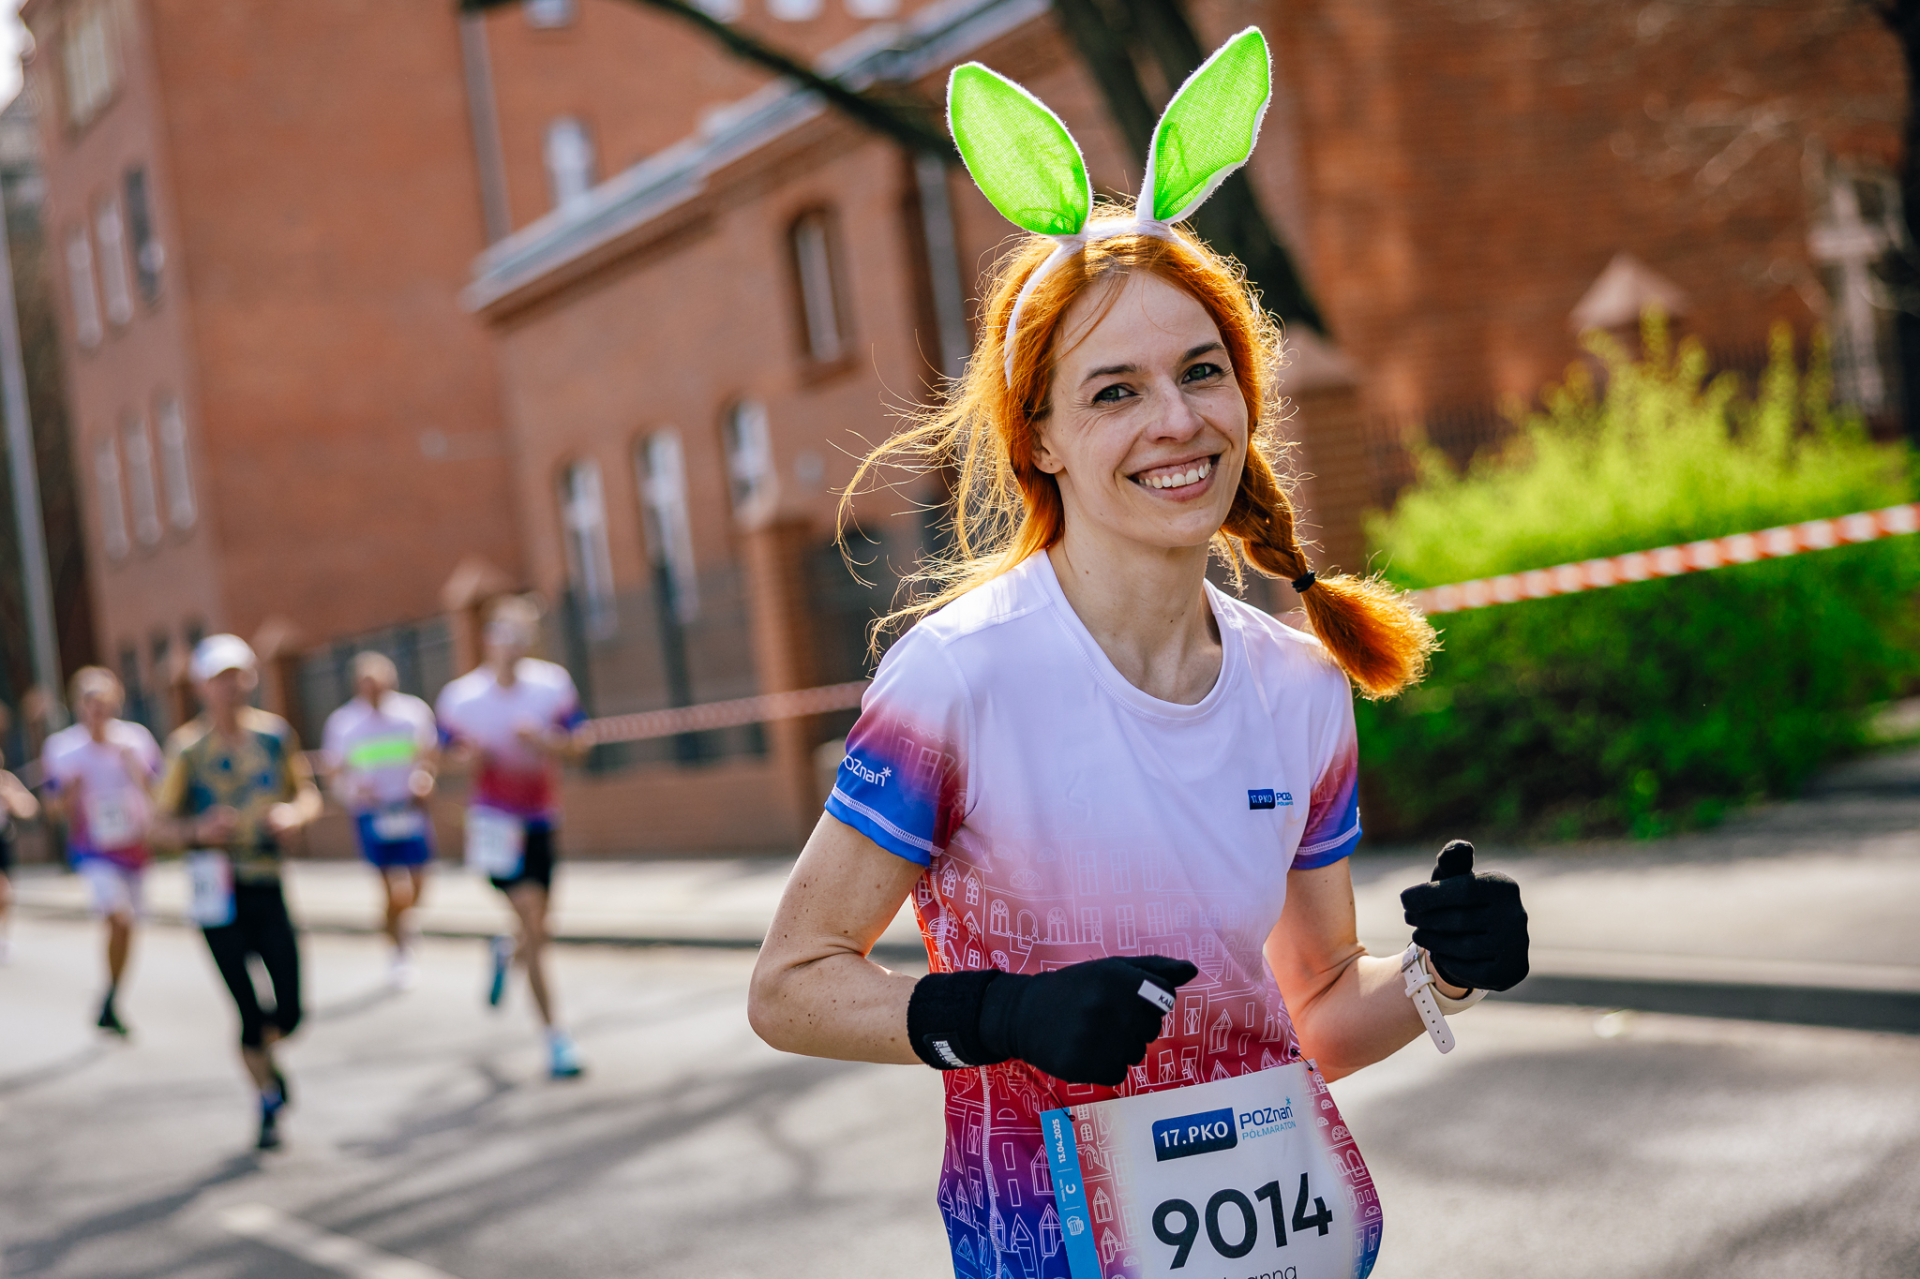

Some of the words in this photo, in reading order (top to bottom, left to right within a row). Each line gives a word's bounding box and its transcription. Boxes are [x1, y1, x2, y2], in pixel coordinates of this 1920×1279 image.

[1052, 1118, 1066, 1164] 13.04.2025
[1242, 1120, 1297, 1140] PÓŁMARATON
[1065, 1183, 1076, 1194] C
[1152, 1172, 1333, 1270] 9014
